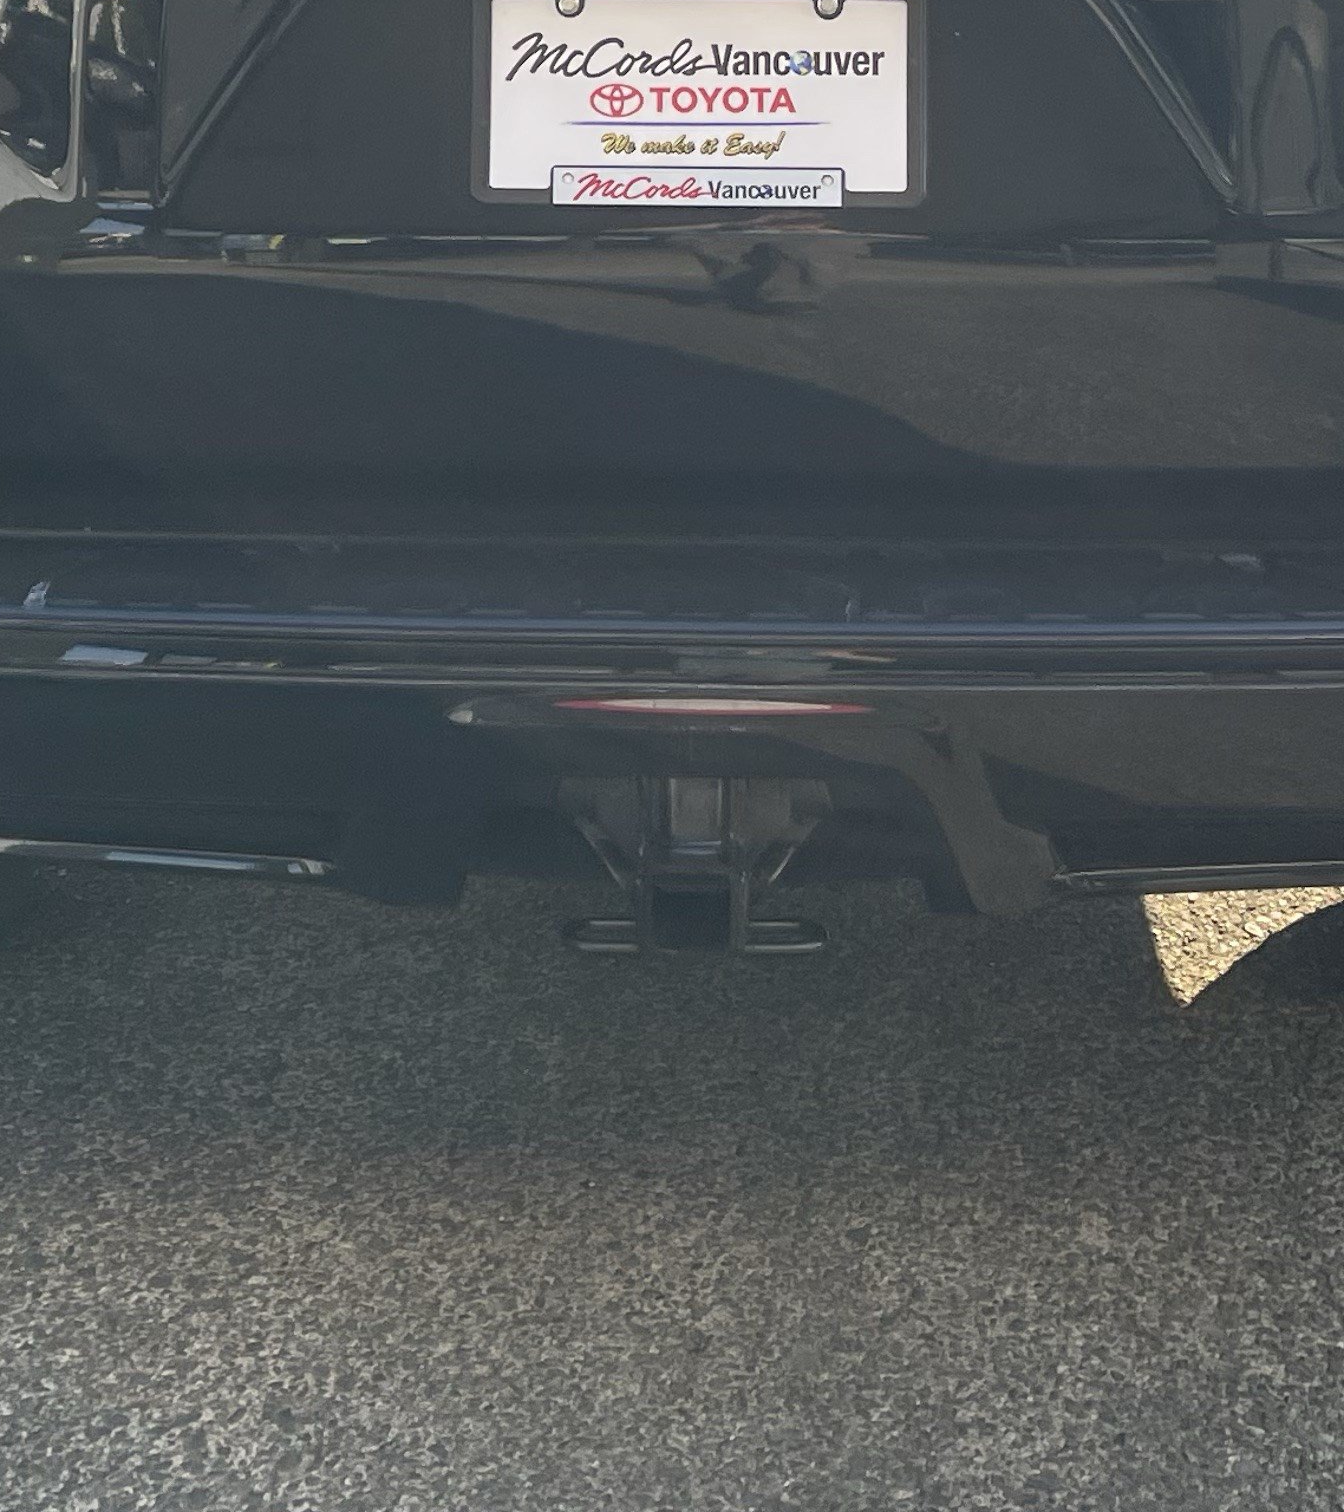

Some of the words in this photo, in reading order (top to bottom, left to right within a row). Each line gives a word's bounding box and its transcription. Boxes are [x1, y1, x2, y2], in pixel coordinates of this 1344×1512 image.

[649, 86, 796, 114] TOYOTA
[601, 132, 636, 155] We
[641, 135, 695, 155] make
[700, 137, 719, 156] it
[723, 130, 786, 160] Easy!
